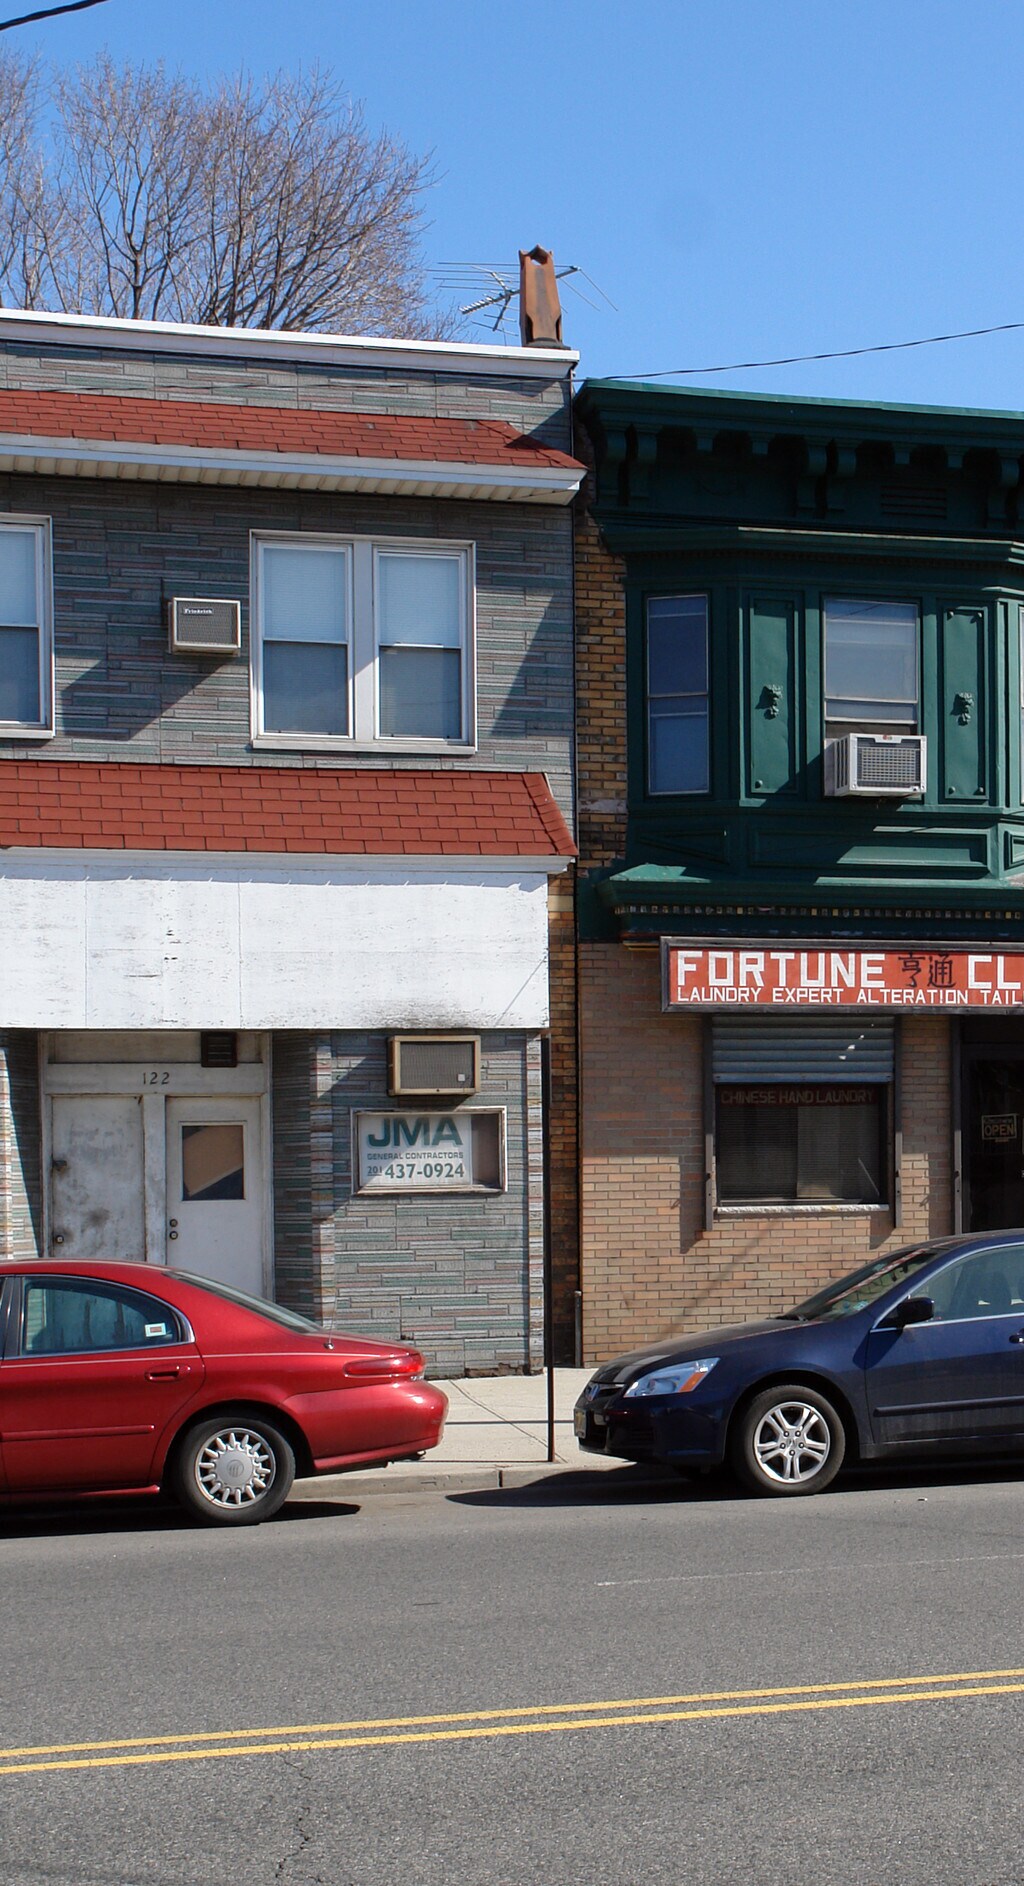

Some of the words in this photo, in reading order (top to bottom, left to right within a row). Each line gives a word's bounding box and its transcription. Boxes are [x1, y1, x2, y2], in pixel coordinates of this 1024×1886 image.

[677, 950, 886, 989] FORTUNE
[898, 952, 957, 989] 亨通
[677, 986, 762, 1003] LAUNDRY
[772, 988, 844, 1004] EXPERT
[856, 988, 969, 1005] ALTERATION
[143, 1071, 170, 1085] 122
[721, 1090, 777, 1104] CHINESE
[778, 1090, 814, 1104] HAND
[815, 1089, 873, 1103] LAUNDRY
[367, 1117, 464, 1148] JMA
[984, 1124, 1015, 1137] OPEN
[367, 1152, 404, 1160] GENERAL
[405, 1151, 464, 1160] CONTRACTORS
[367, 1165, 382, 1175] 201
[384, 1162, 465, 1179] 437-0924
